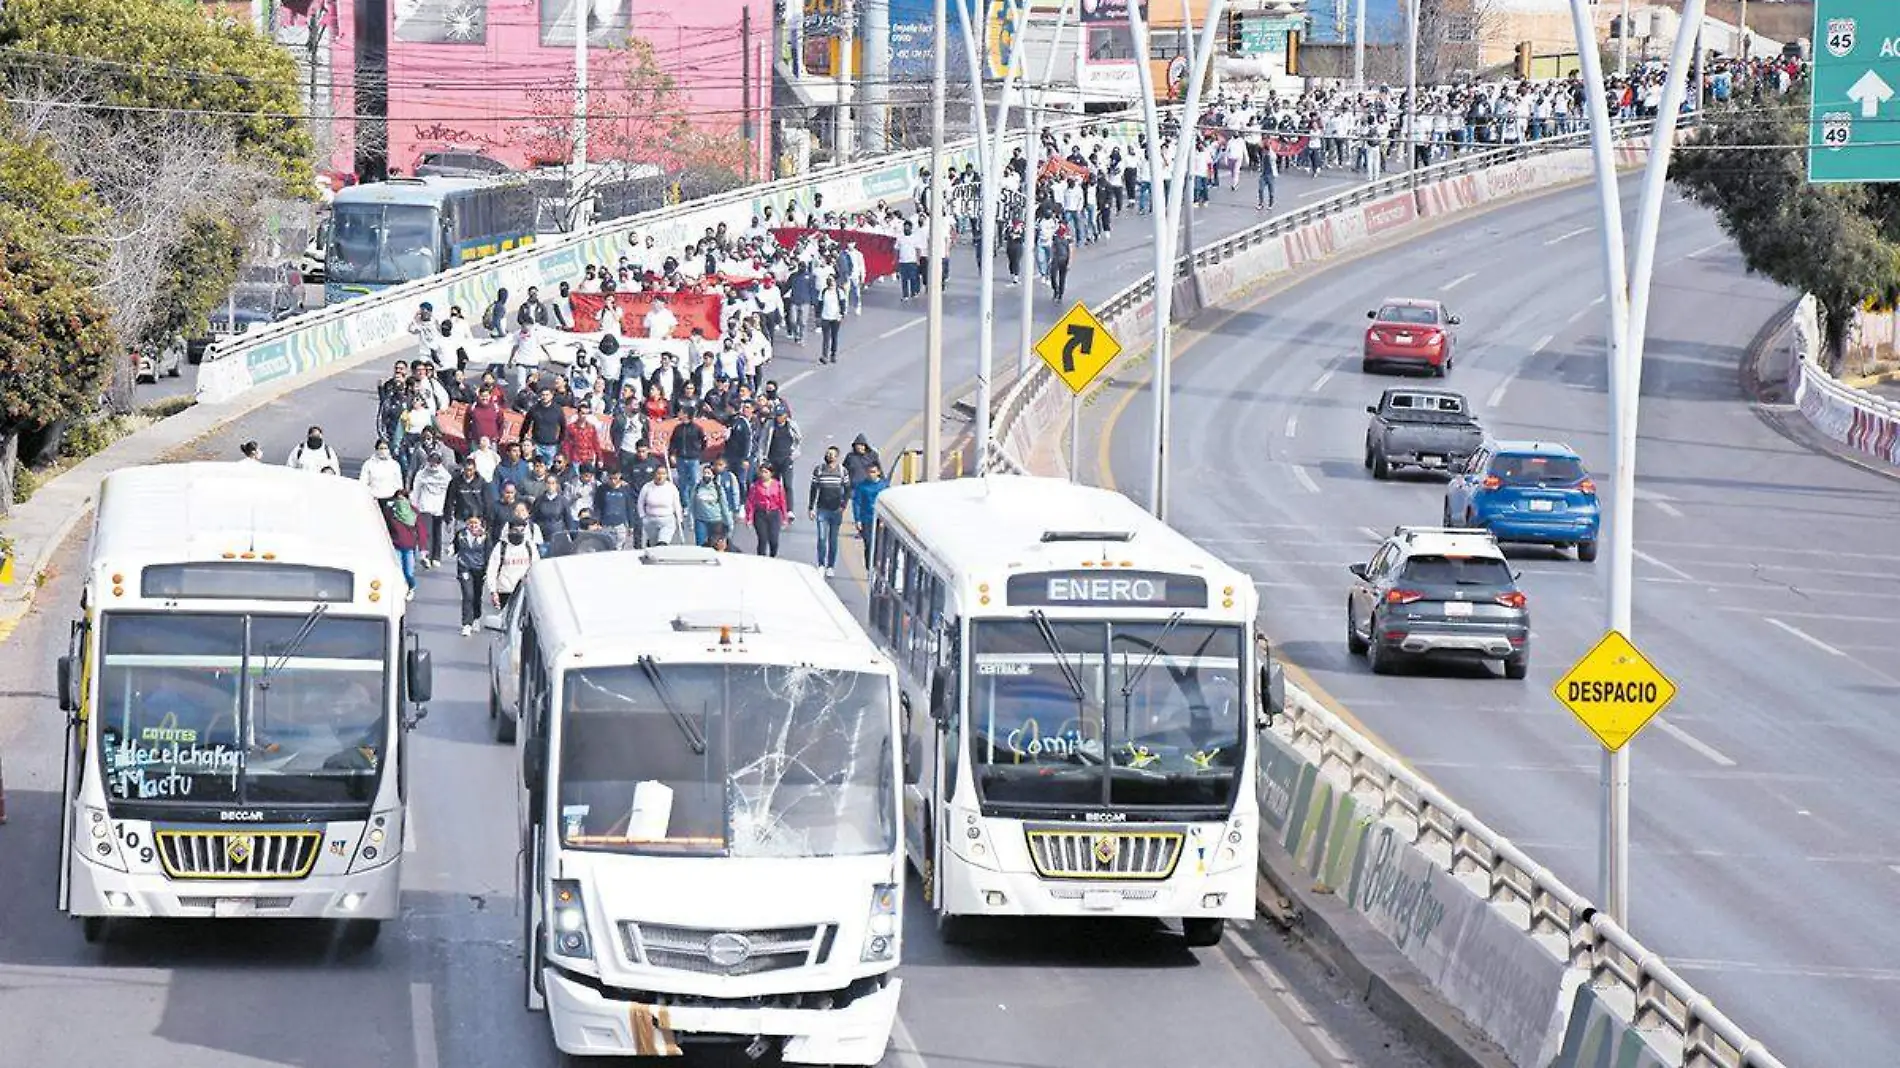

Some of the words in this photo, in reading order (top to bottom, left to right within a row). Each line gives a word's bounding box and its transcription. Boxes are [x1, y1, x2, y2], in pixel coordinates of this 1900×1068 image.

[1829, 35, 1852, 48] 45
[1825, 128, 1847, 142] 49
[1049, 579, 1154, 601] ENERO
[1568, 681, 1657, 703] DESPACIO
[142, 727, 197, 742] COYOTES
[115, 822, 154, 863] 109
